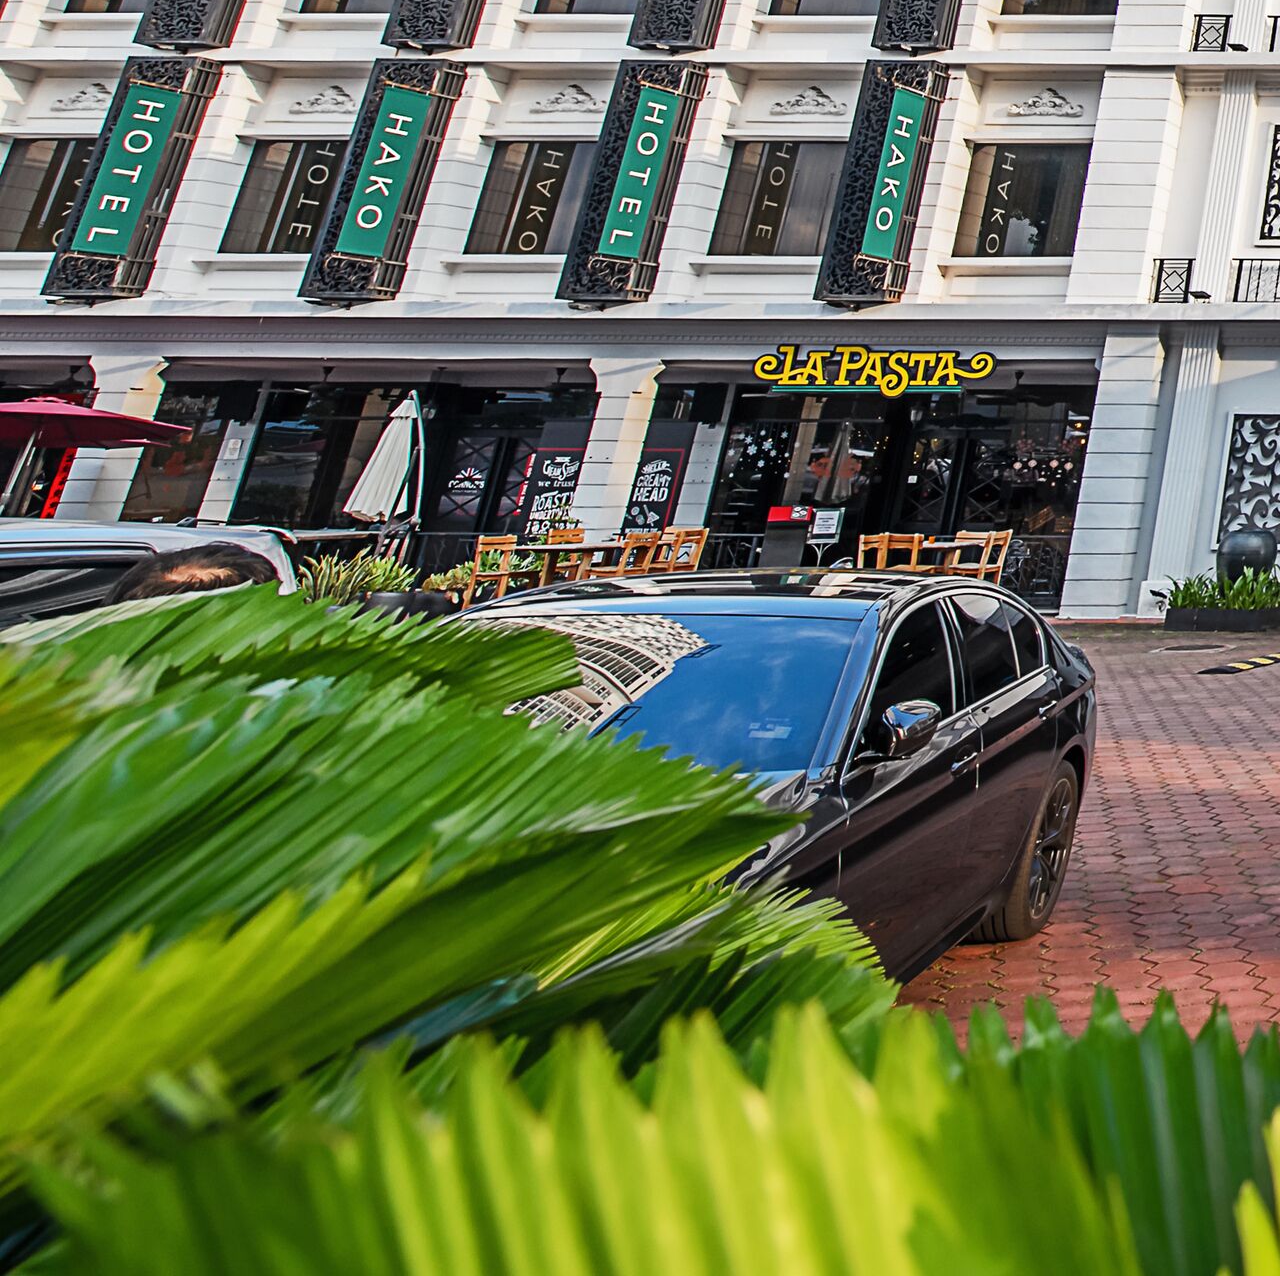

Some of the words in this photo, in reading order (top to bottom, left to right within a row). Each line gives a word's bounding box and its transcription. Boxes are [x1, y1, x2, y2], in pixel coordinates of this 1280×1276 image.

[87, 99, 166, 242] HOTEL
[356, 112, 413, 229] HAKO
[609, 101, 668, 244] HOTEL
[875, 115, 914, 231] HAKO
[753, 345, 831, 386] LA
[833, 345, 995, 398] PASTA
[553, 480, 576, 488] trust
[632, 486, 669, 502] HEAD
[636, 473, 672, 488] CREAMY
